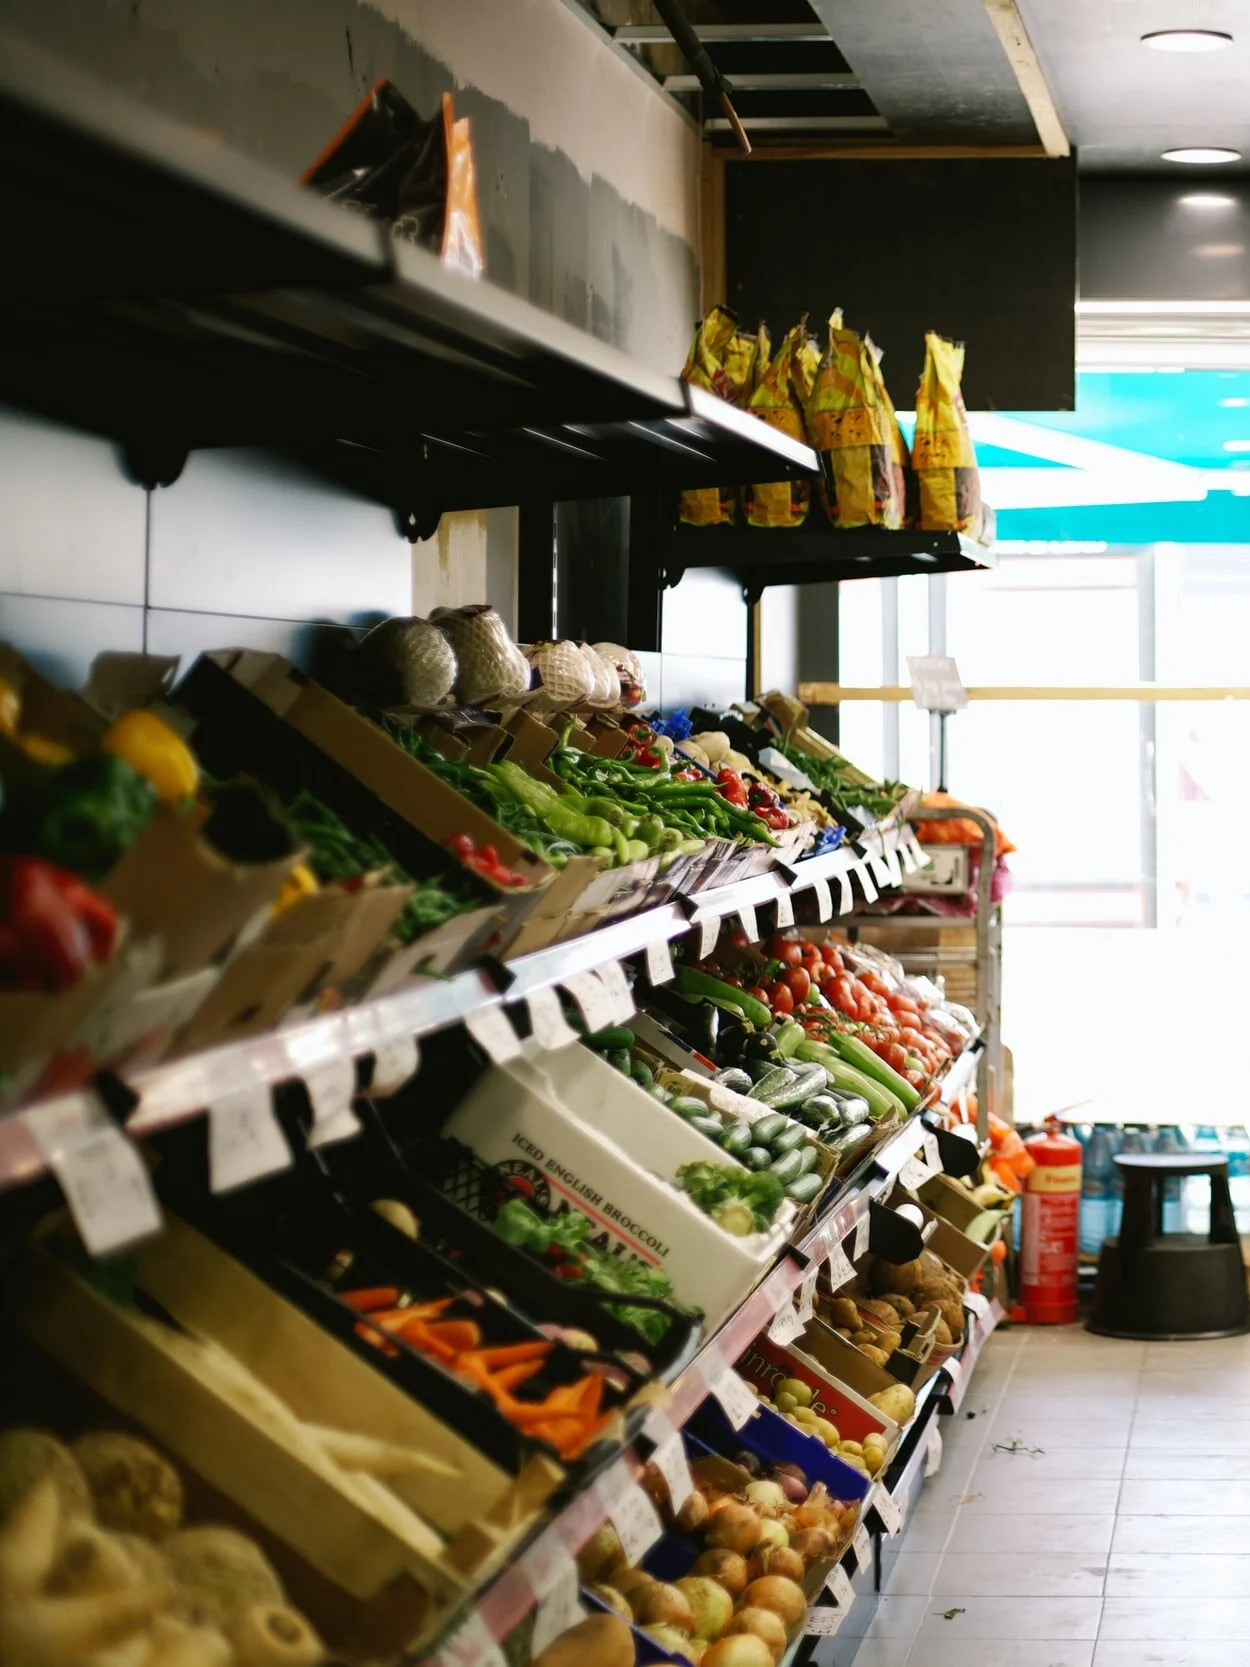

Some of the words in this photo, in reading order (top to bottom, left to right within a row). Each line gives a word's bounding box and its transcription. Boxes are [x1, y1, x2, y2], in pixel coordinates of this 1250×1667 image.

[511, 1133, 545, 1161] ICED
[544, 1159, 604, 1207] ENGLISH
[602, 1202, 671, 1259] BROCCOLI
